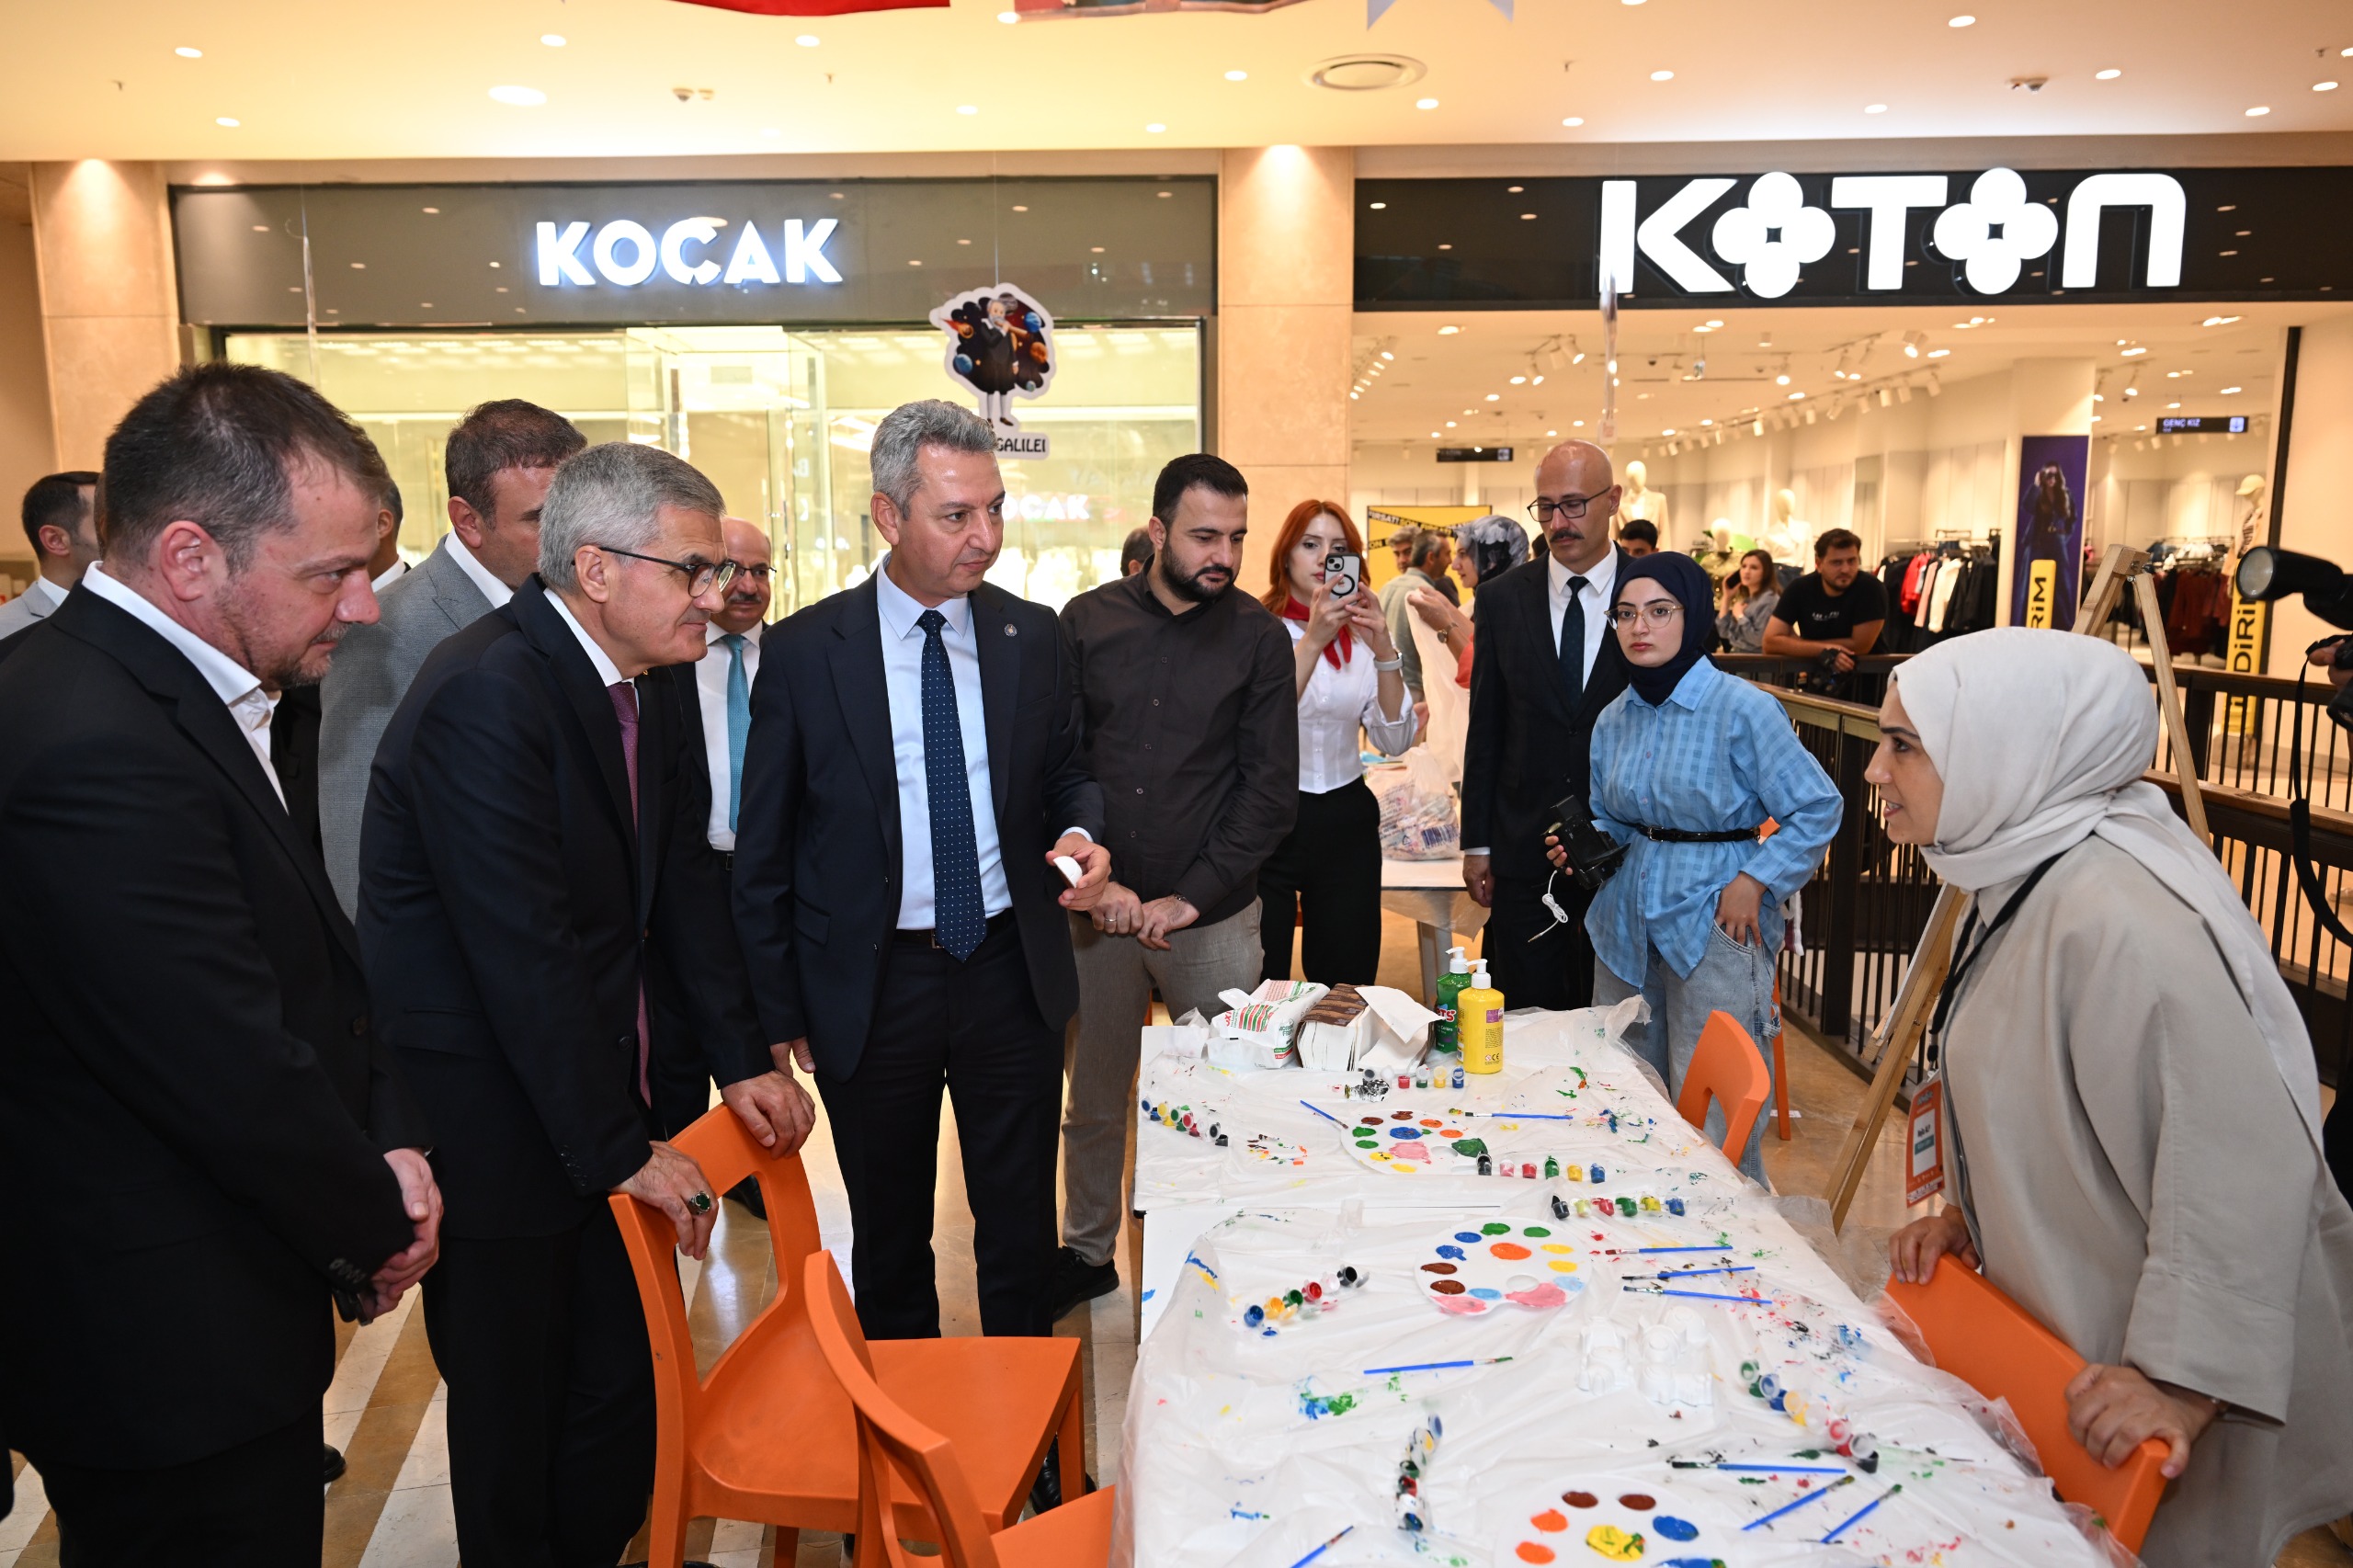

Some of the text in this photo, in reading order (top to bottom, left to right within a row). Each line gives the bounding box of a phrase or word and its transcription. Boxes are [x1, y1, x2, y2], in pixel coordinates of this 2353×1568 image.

[1598, 168, 2187, 299] KOTON
[996, 437, 1046, 452] GALILEI
[1002, 494, 1090, 520] OCAK
